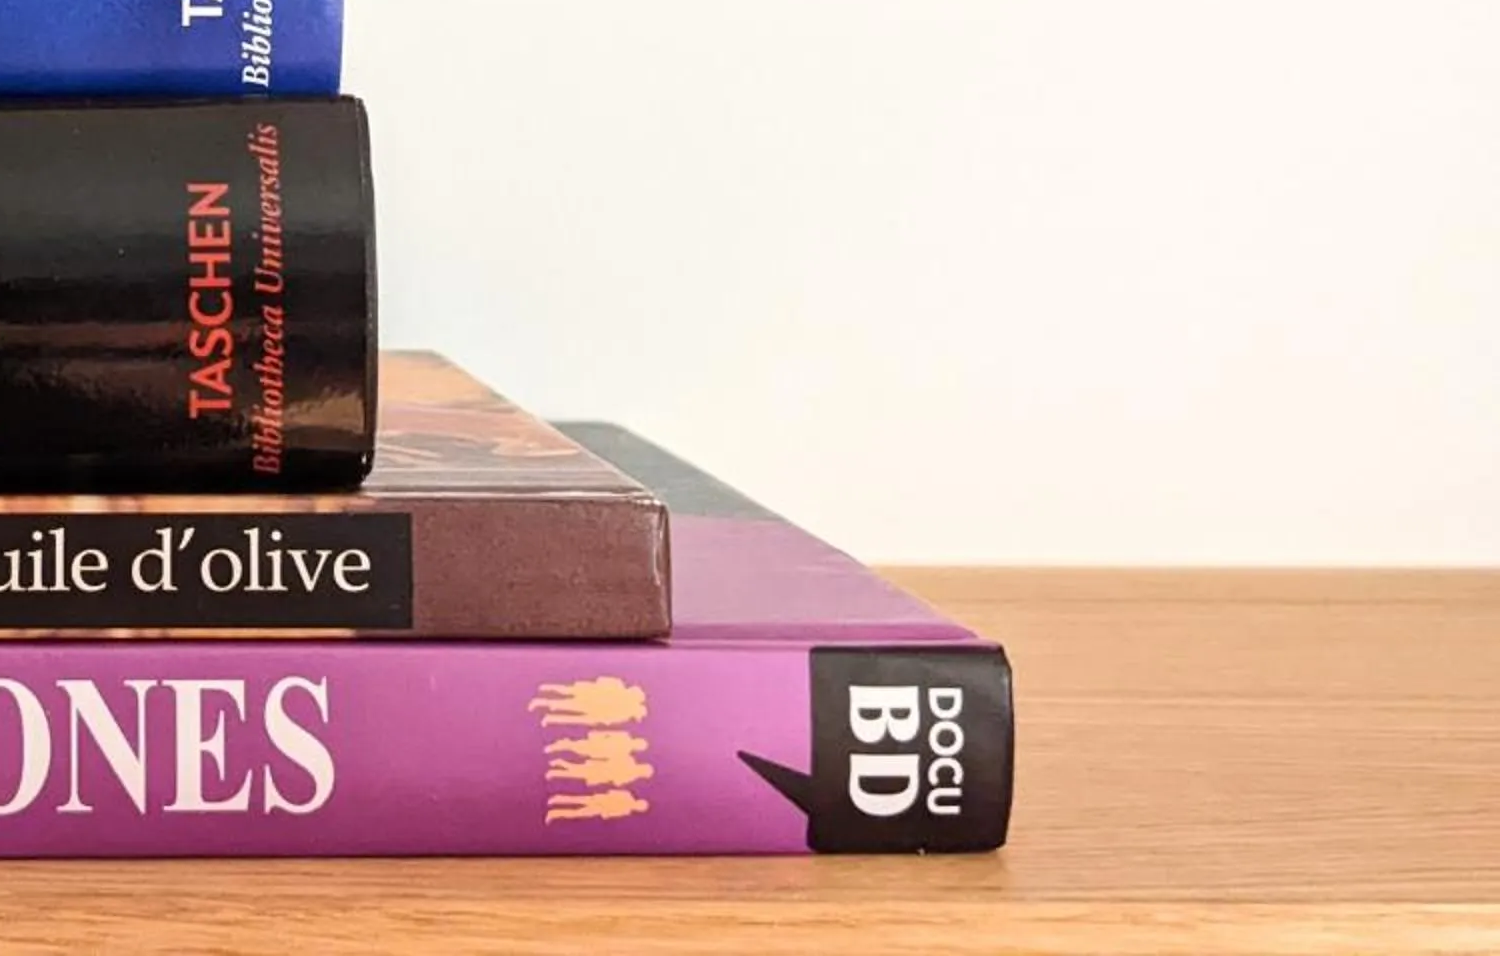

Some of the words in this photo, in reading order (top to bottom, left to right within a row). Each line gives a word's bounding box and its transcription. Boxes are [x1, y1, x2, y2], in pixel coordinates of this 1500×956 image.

[248, 123, 283, 294] Universalis
[187, 184, 234, 419] TASCHEN
[253, 305, 285, 474] Bibliotheca
[131, 528, 371, 593] d'olive
[849, 685, 920, 817] BD
[927, 687, 965, 815] DOCU
